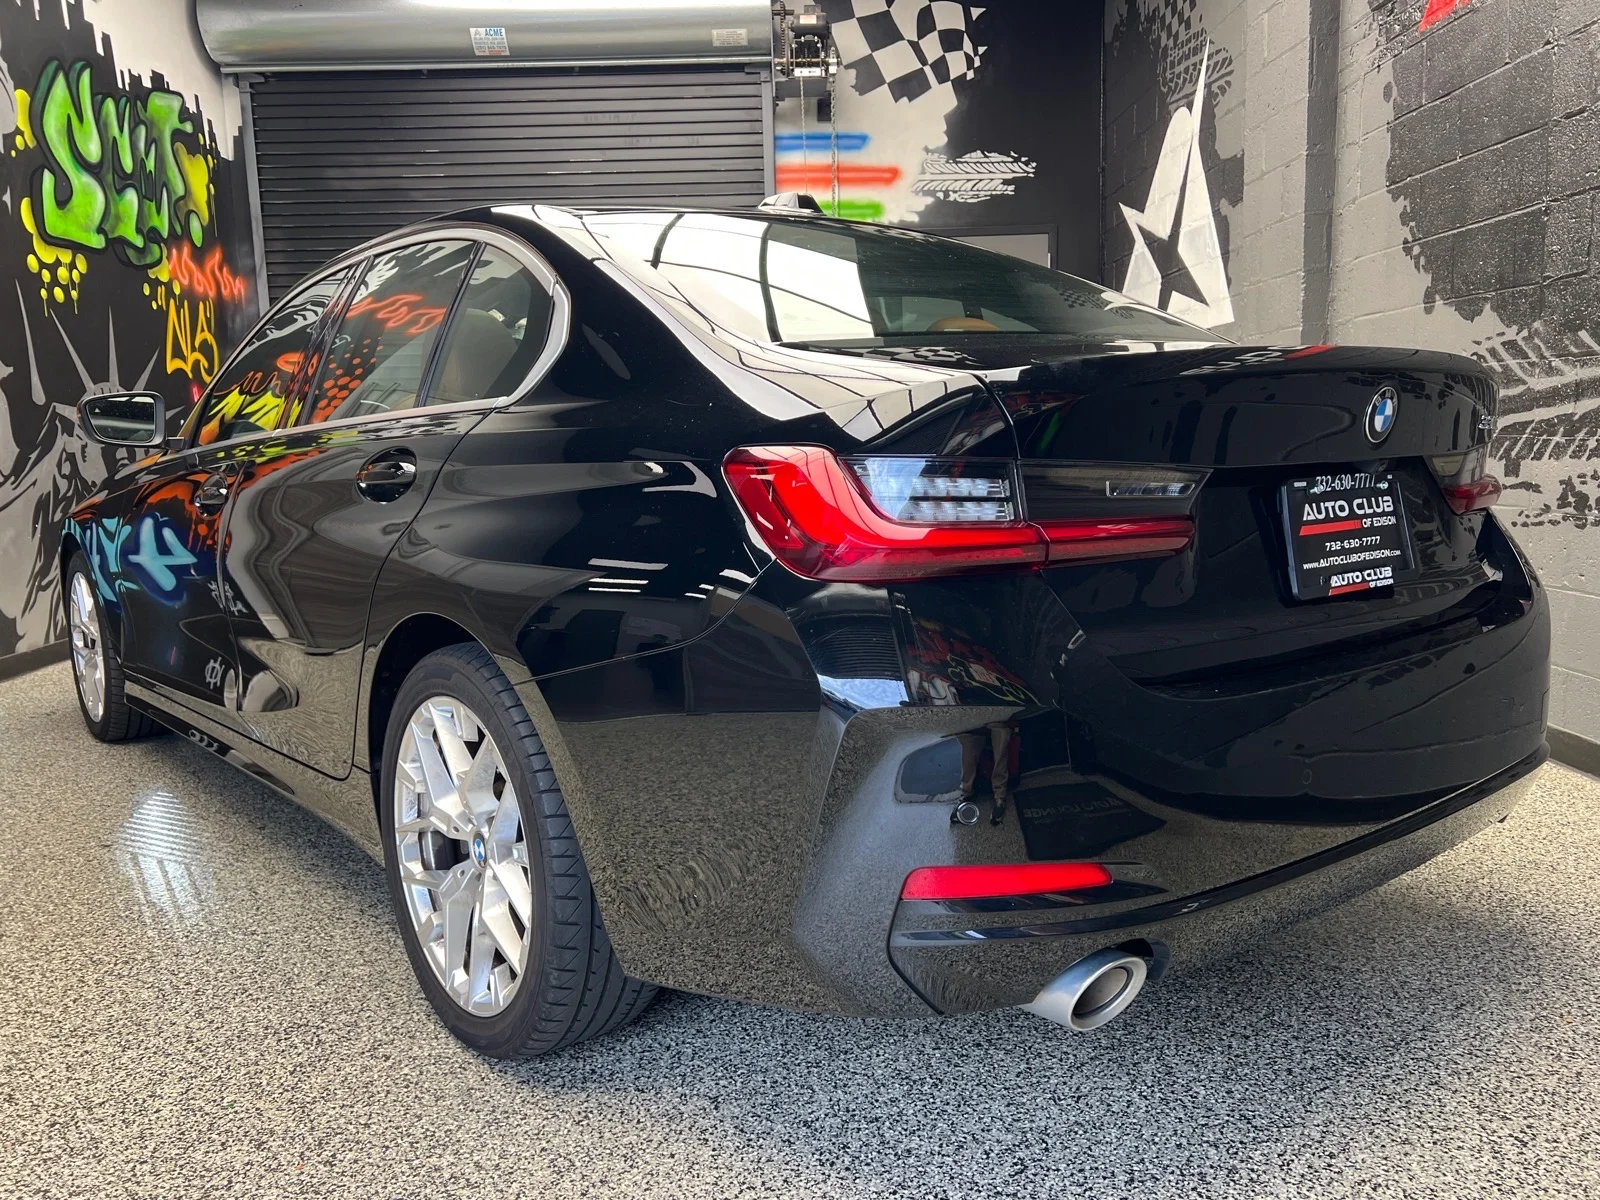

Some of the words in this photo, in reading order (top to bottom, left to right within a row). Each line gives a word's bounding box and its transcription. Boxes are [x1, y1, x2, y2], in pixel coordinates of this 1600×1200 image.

[484, 28, 504, 37] ACME
[1303, 500, 1350, 521] AUTO
[1353, 496, 1394, 515] CLUB
[1362, 518, 1372, 528] OF
[1373, 516, 1397, 527] EDISON
[1325, 535, 1381, 551] 732-630-7777
[1331, 571, 1362, 587] AUTO
[1363, 566, 1393, 581] CLUB
[1377, 578, 1394, 587] EDISON
